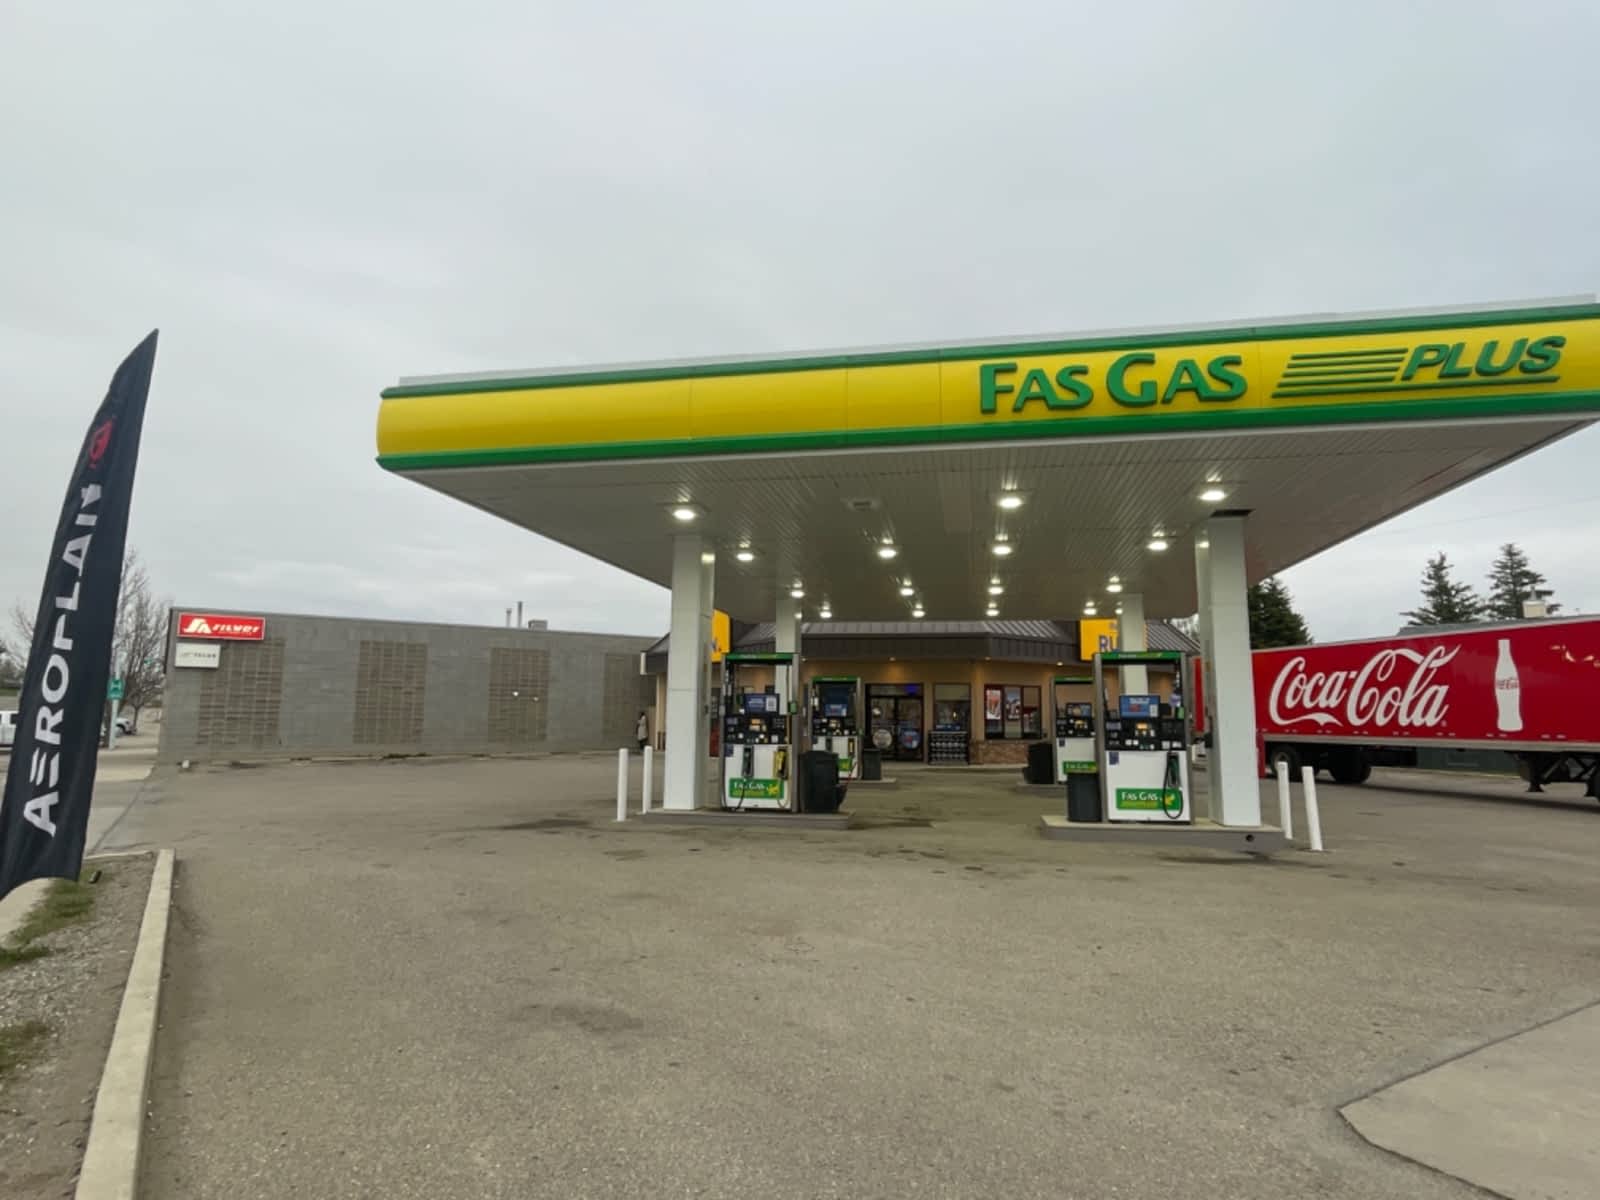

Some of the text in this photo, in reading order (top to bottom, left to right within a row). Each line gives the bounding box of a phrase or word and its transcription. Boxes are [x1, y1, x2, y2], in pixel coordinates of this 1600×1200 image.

[980, 336, 1566, 414] FAS GAS PLUS
[1269, 644, 1462, 728] Coca-Cola
